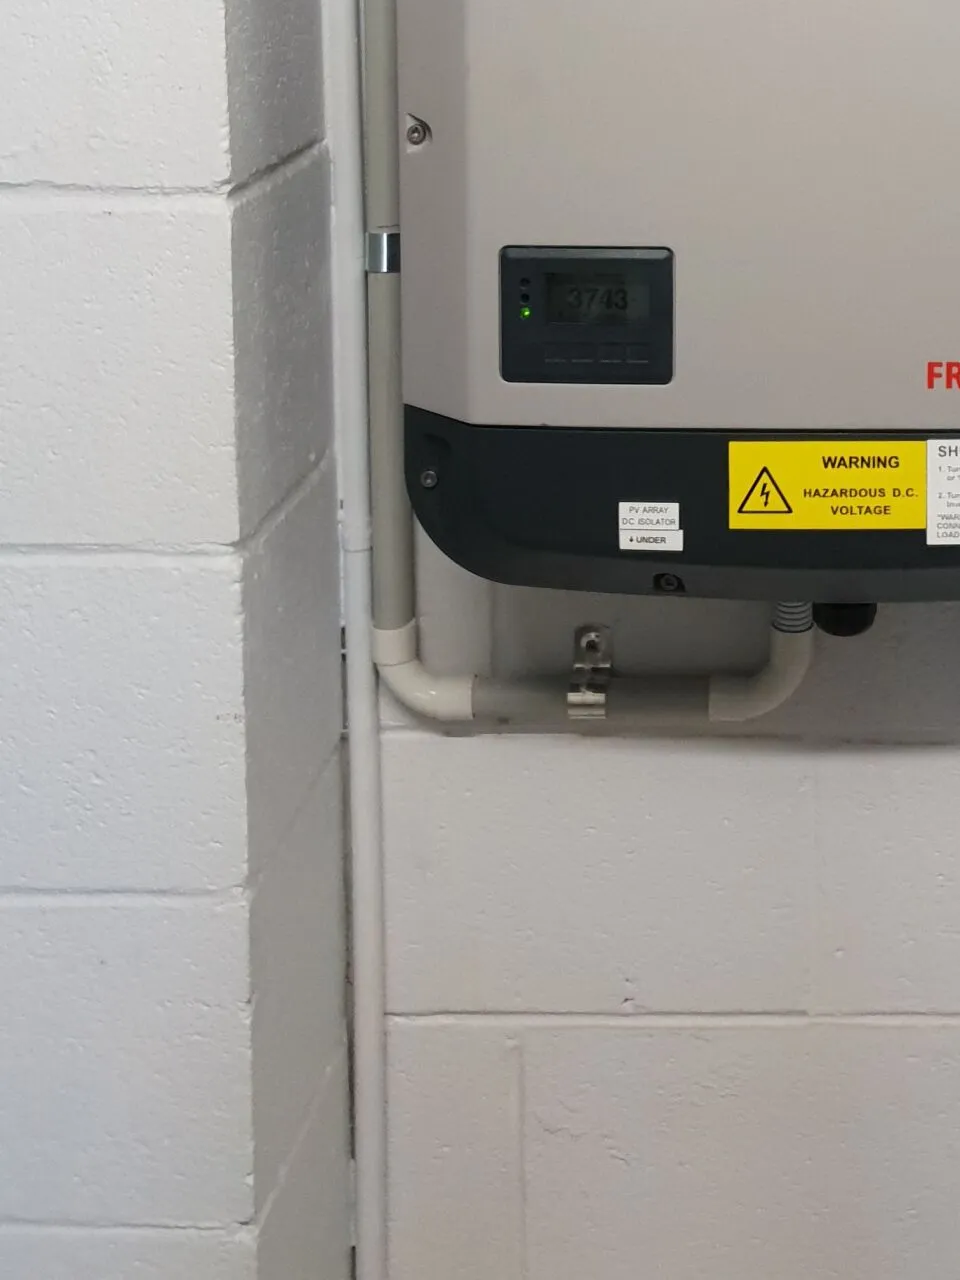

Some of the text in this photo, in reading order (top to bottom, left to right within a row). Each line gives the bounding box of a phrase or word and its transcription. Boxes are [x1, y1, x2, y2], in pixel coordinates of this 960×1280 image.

[567, 288, 628, 311] 3743
[822, 455, 900, 469] WARNING
[803, 488, 918, 498] HAZARDOUS D.C.
[830, 505, 891, 515] VOLTAGE
[622, 517, 676, 525] DC ISOLATOR
[636, 536, 666, 544] UNDER
